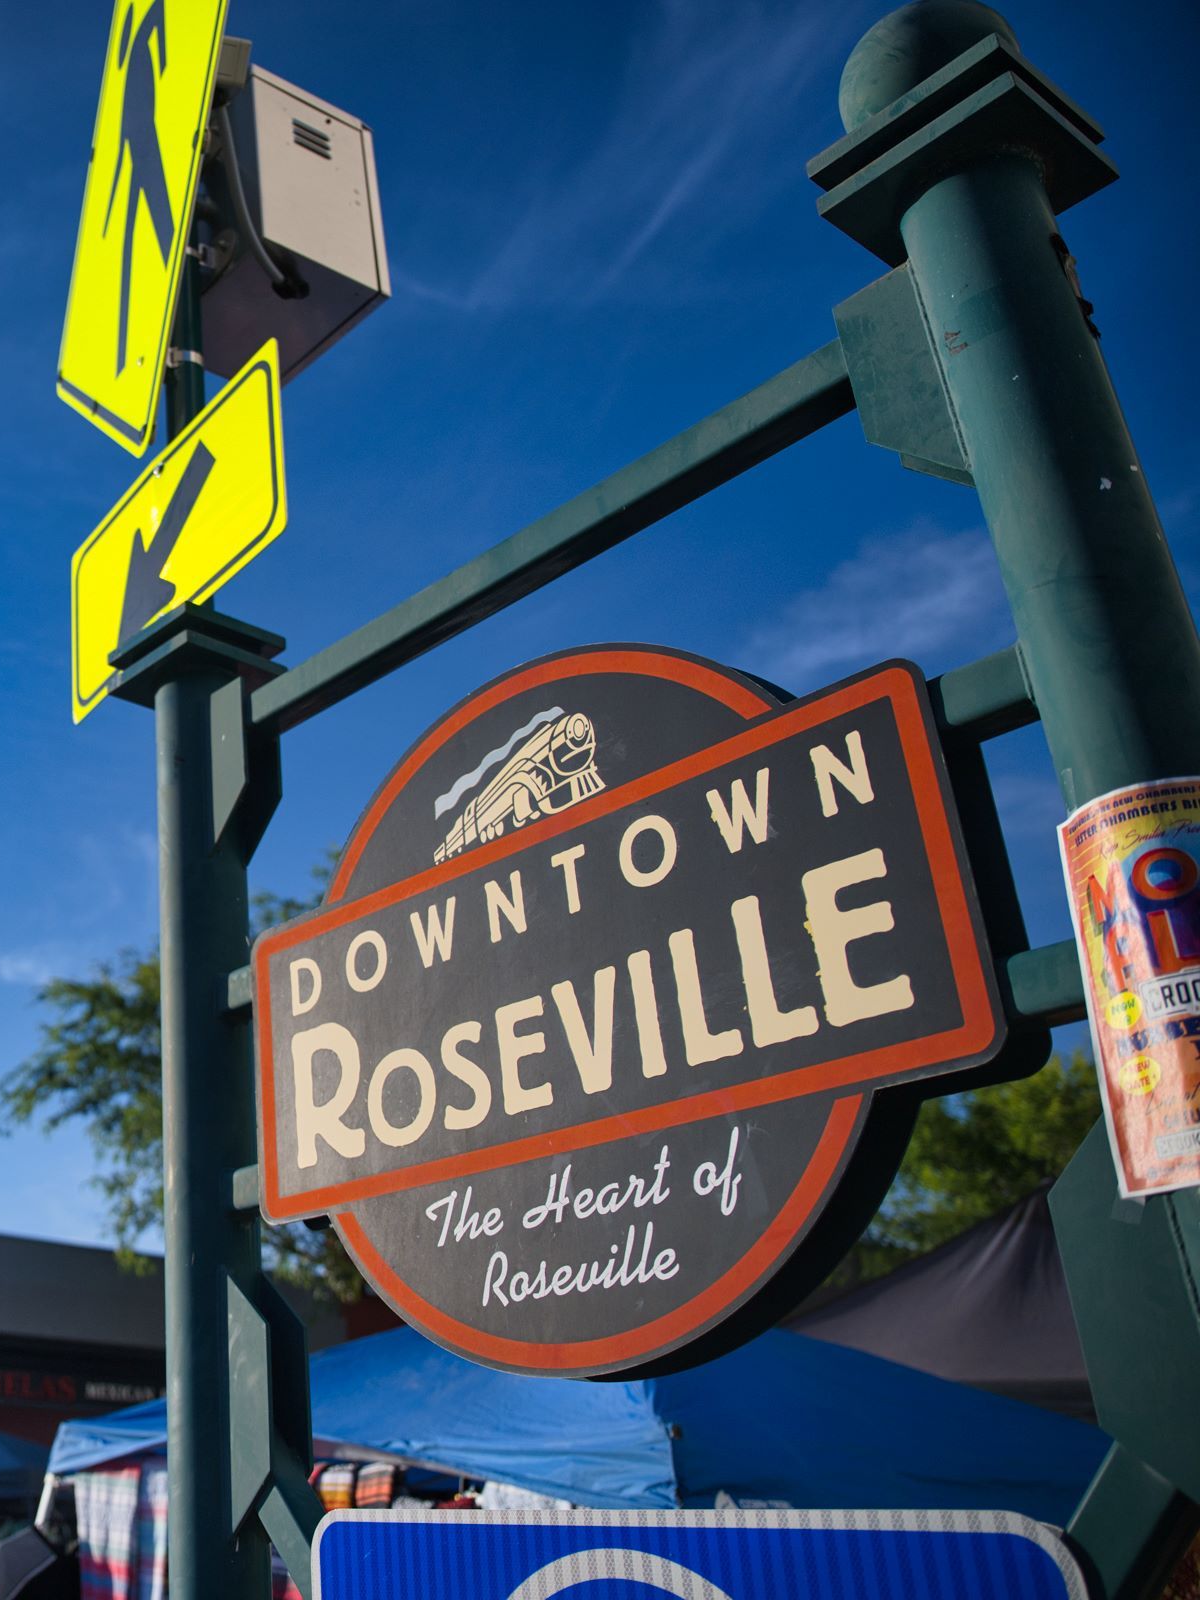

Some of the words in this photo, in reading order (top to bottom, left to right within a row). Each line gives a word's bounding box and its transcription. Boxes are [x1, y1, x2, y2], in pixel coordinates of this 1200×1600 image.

[289, 730, 875, 1016] DOWNTOWN
[1100, 799, 1178, 829] CHAMBERS
[290, 847, 915, 1170] ROSEVILLE
[425, 1185, 504, 1248] The
[522, 1145, 670, 1229] Heart
[692, 1126, 743, 1215] of
[482, 1223, 680, 1307] Roseville
